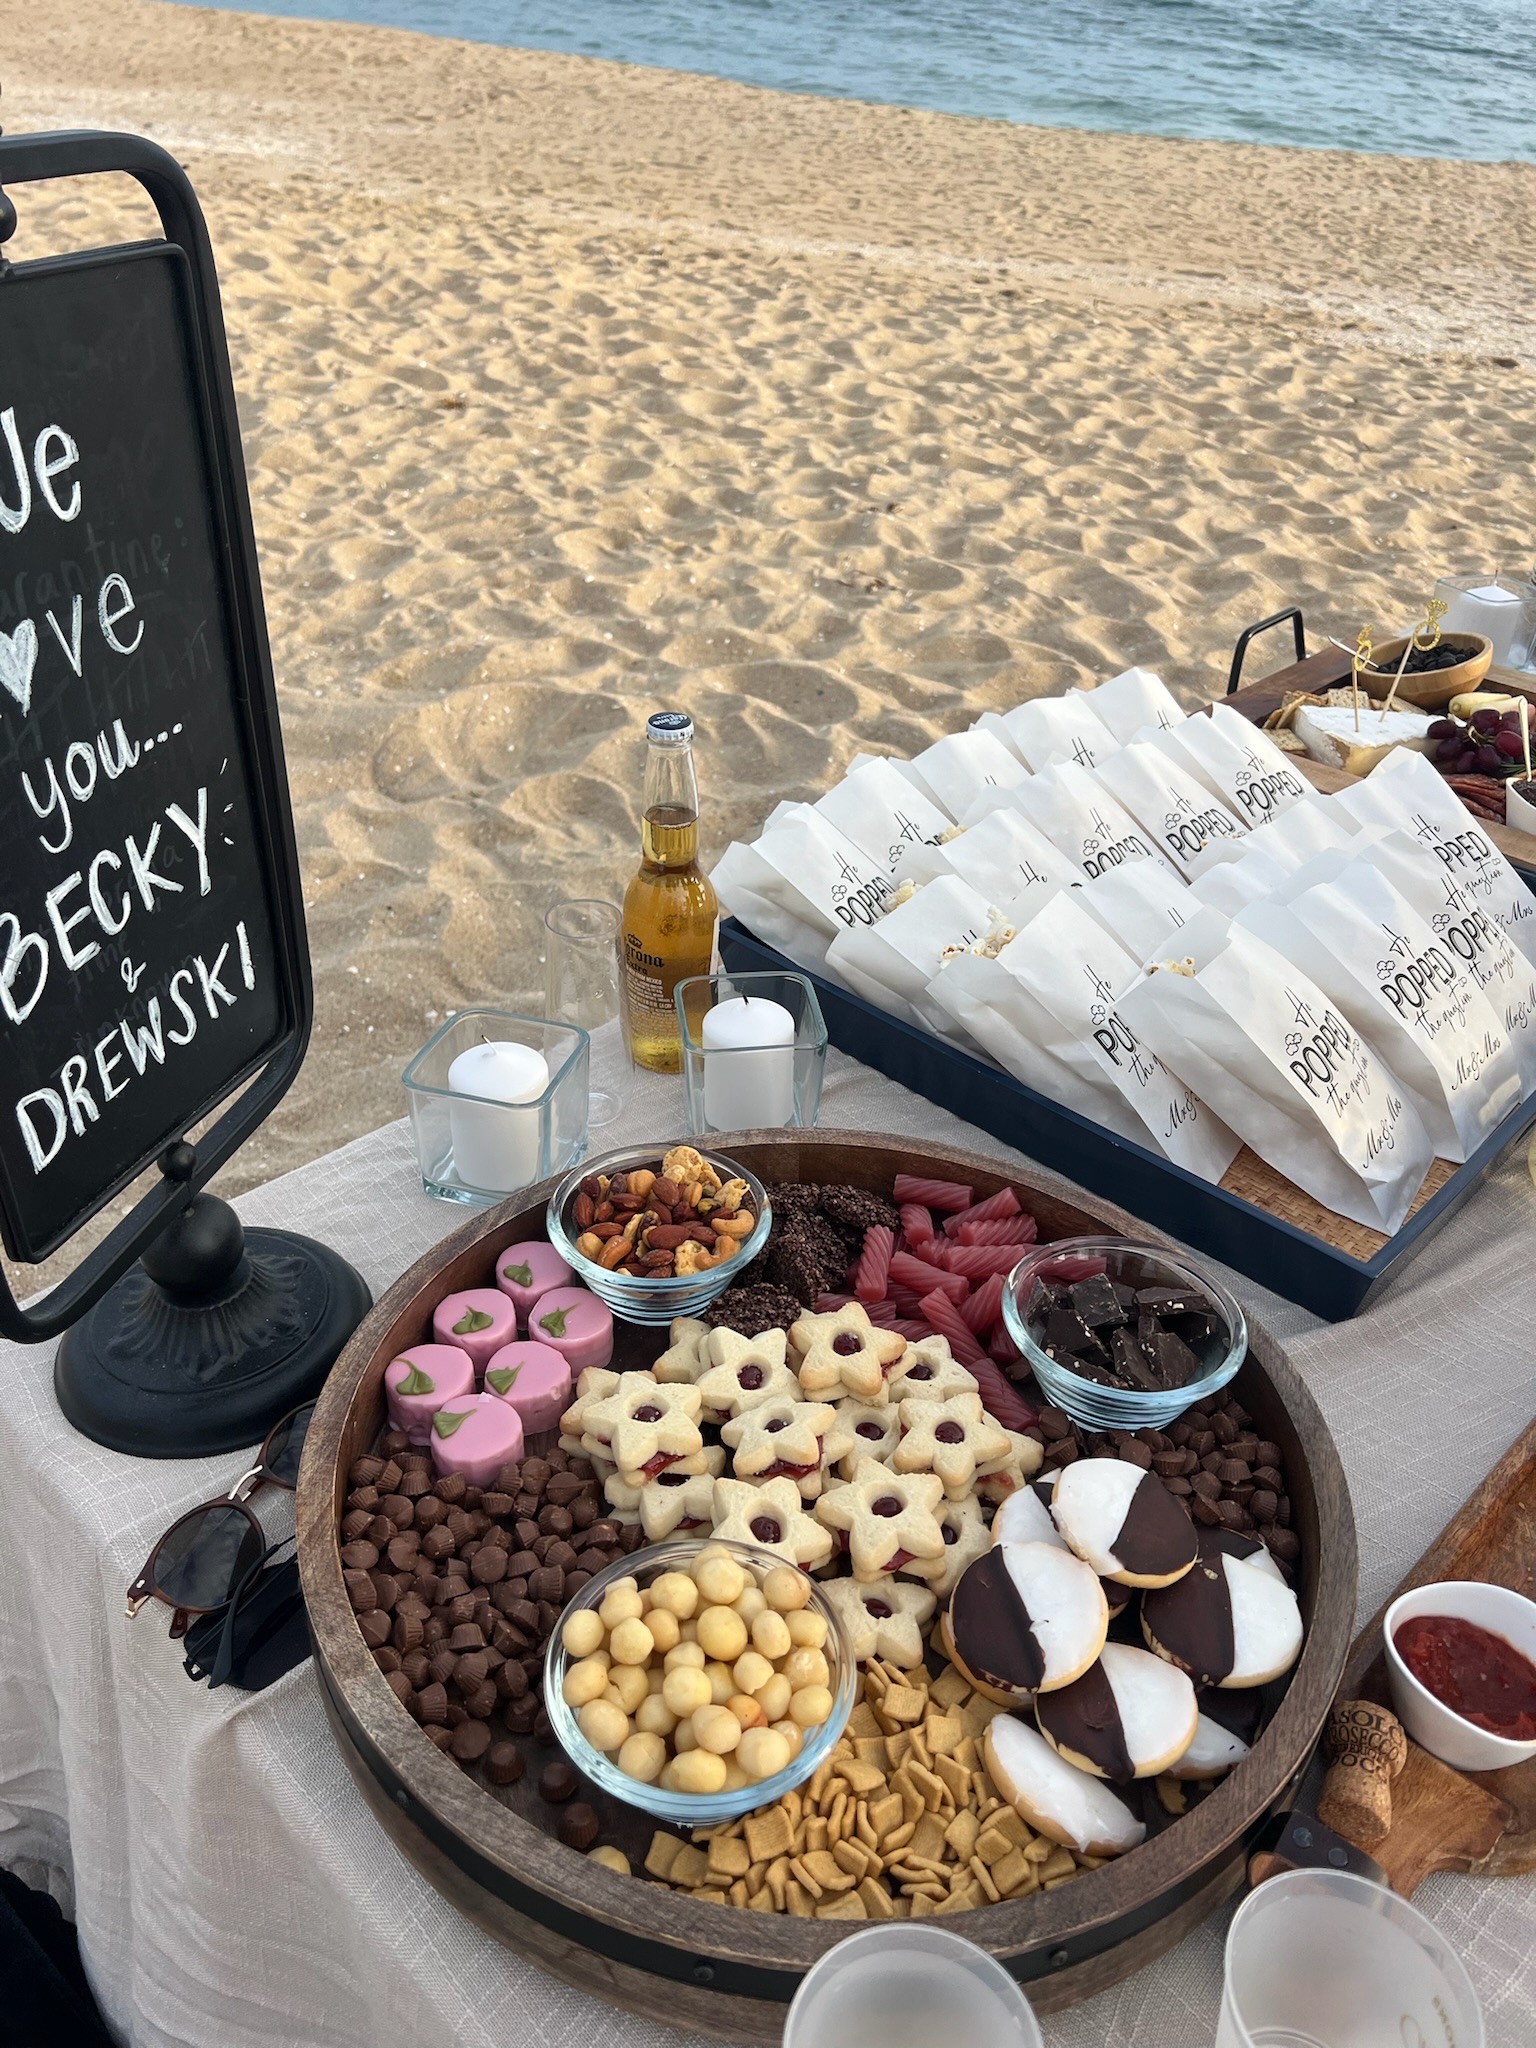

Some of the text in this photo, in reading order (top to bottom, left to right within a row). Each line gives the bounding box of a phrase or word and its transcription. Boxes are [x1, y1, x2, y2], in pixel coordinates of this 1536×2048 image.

[1072, 737, 1095, 768] He
[1241, 746, 1268, 775] He
[1166, 787, 1197, 815] He
[1236, 771, 1304, 817] POPPED
[894, 810, 924, 842] He
[1090, 807, 1115, 843] He
[1165, 809, 1235, 862] POPPED
[1411, 814, 1442, 843] He
[833, 851, 863, 885] He
[1433, 831, 1491, 873] PPED
[1440, 873, 1470, 912] He
[625, 943, 664, 968] orona
[1382, 923, 1415, 959] He
[121, 956, 147, 993] &
[1083, 964, 1116, 1003] He
[1380, 947, 1457, 1019] POPPED
[1468, 961, 1493, 991] the
[1284, 986, 1319, 1028] He
[1415, 1008, 1442, 1040] the
[16, 921, 256, 1175] DREWSKI
[1289, 1010, 1350, 1097] POPPED
[1326, 1082, 1350, 1118] the
